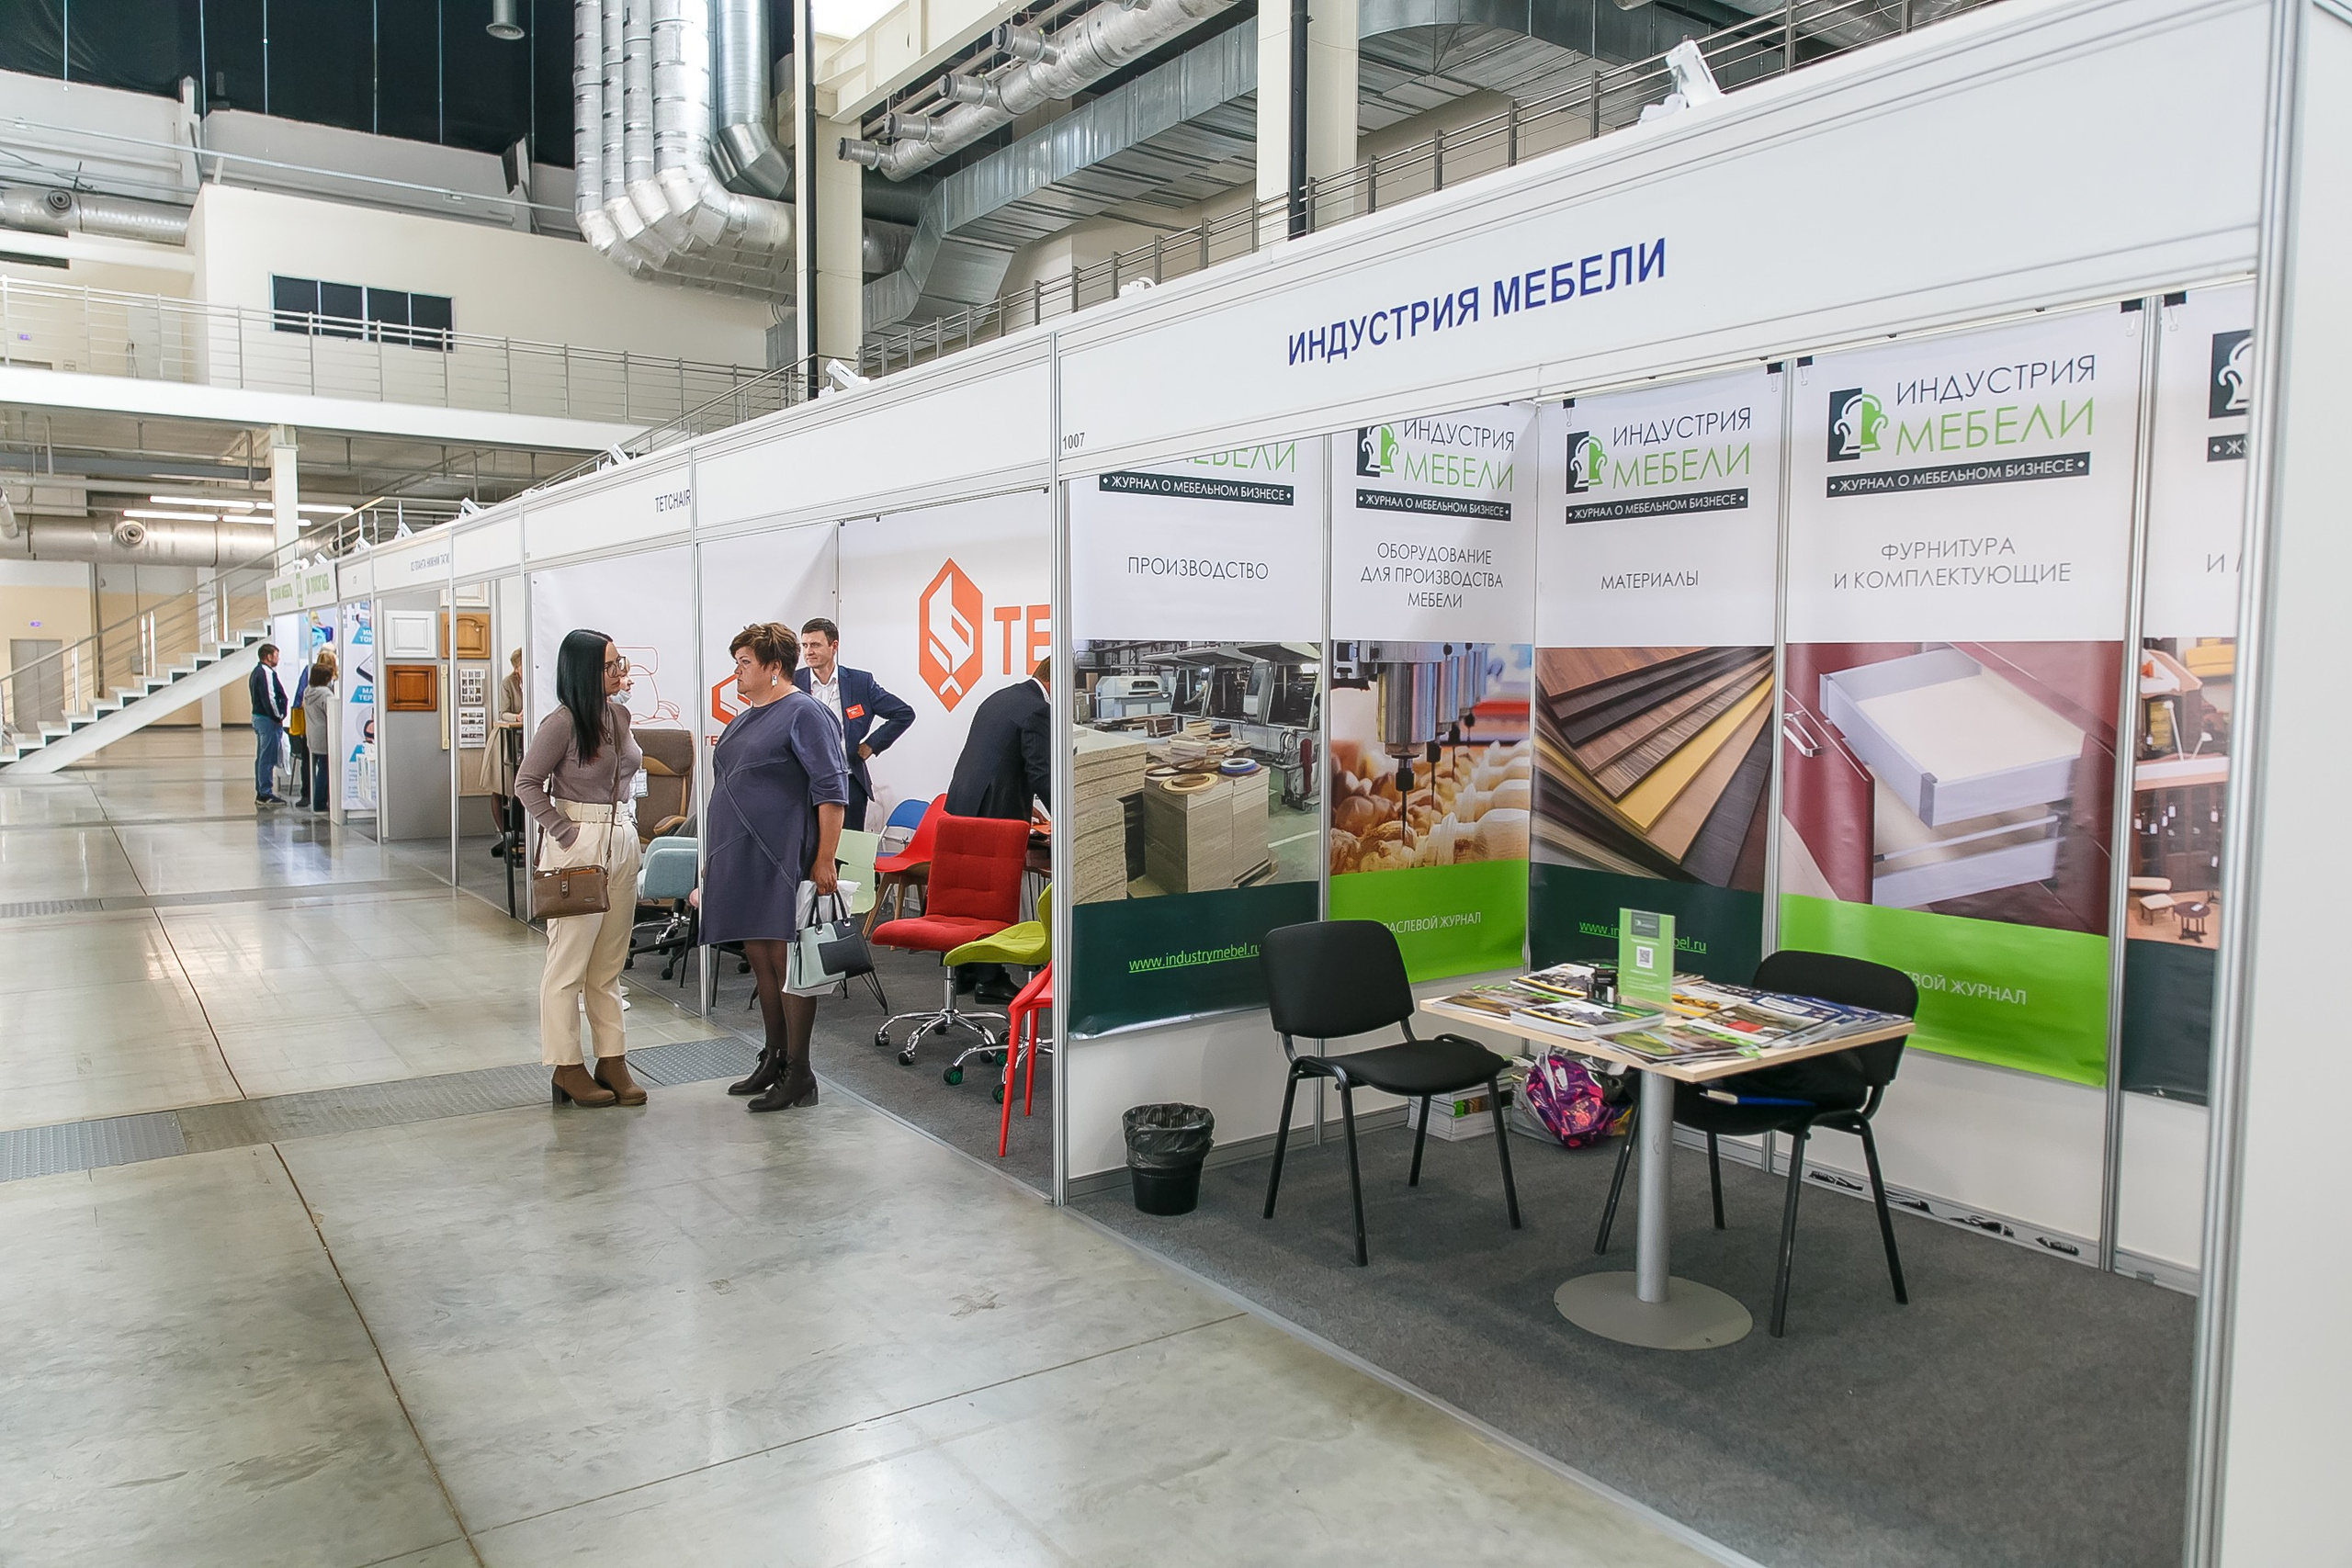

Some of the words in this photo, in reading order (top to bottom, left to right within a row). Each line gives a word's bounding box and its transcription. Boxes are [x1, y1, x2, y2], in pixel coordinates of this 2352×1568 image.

[1288, 287, 1479, 366] ИНДУСТРИЯ
[1493, 237, 1666, 318] МЕБЕЛИ
[1896, 355, 2096, 406] ИНДУСТРИЯ
[1403, 420, 1515, 451] ИНДУСТРИЯ
[1613, 407, 1751, 447] ИНДУСТРИЯ
[1895, 397, 2094, 456] МЕБЕЛИ
[1062, 432, 1085, 450] 1007
[1403, 451, 1514, 492] МЕБЕЛИ
[1612, 442, 1750, 490] МЕБЕЛИ
[1838, 478, 1894, 491] ЖУРНАЛ
[1897, 475, 1910, 488] О
[1912, 466, 2002, 485] МЕБЕЛЬНОМ
[2006, 458, 2074, 477] БИЗНЕСЕ
[654, 489, 691, 513] TETCHAIR
[1111, 475, 1159, 491] ЖУРНАЛ
[1161, 479, 1171, 491] О
[1173, 480, 1238, 497] МЕБЕЛЬНОМ
[1240, 486, 1284, 501] БИЗНЕСЕ
[1365, 494, 1403, 508] ЖУРНАЛ
[1405, 498, 1413, 508] О
[1415, 499, 1468, 513] МЕБЕЛЬНОМ
[1469, 503, 1504, 517] БИЗНЕСЕ
[1574, 506, 1612, 519] ЖУРНАЛ
[1614, 504, 1623, 516] О
[1625, 499, 1687, 514] МЕБЕЛЬНОМ
[1689, 493, 1736, 509] БИЗНЕСЕ
[1377, 542, 1492, 565] ОБОРУДОВАНИЕ
[1881, 537, 2016, 560] ФУРНИТУРА
[1128, 557, 1269, 580] ПРОИЗВОДСТВО
[1361, 566, 1390, 583] ДЛЯ
[1395, 567, 1503, 588] ПРОИЗВОДСТВА
[1600, 570, 1699, 590] МАТЕРИАЛЫ
[1833, 572, 1847, 590] И
[1853, 562, 2072, 589] КОМПЛЕКТУЮЩИЕ
[1408, 592, 1463, 608] МЕБЕЛИ
[1439, 911, 1481, 929] ЖУРНАЛ
[1951, 979, 2027, 1006] ЖУРНАЛ
